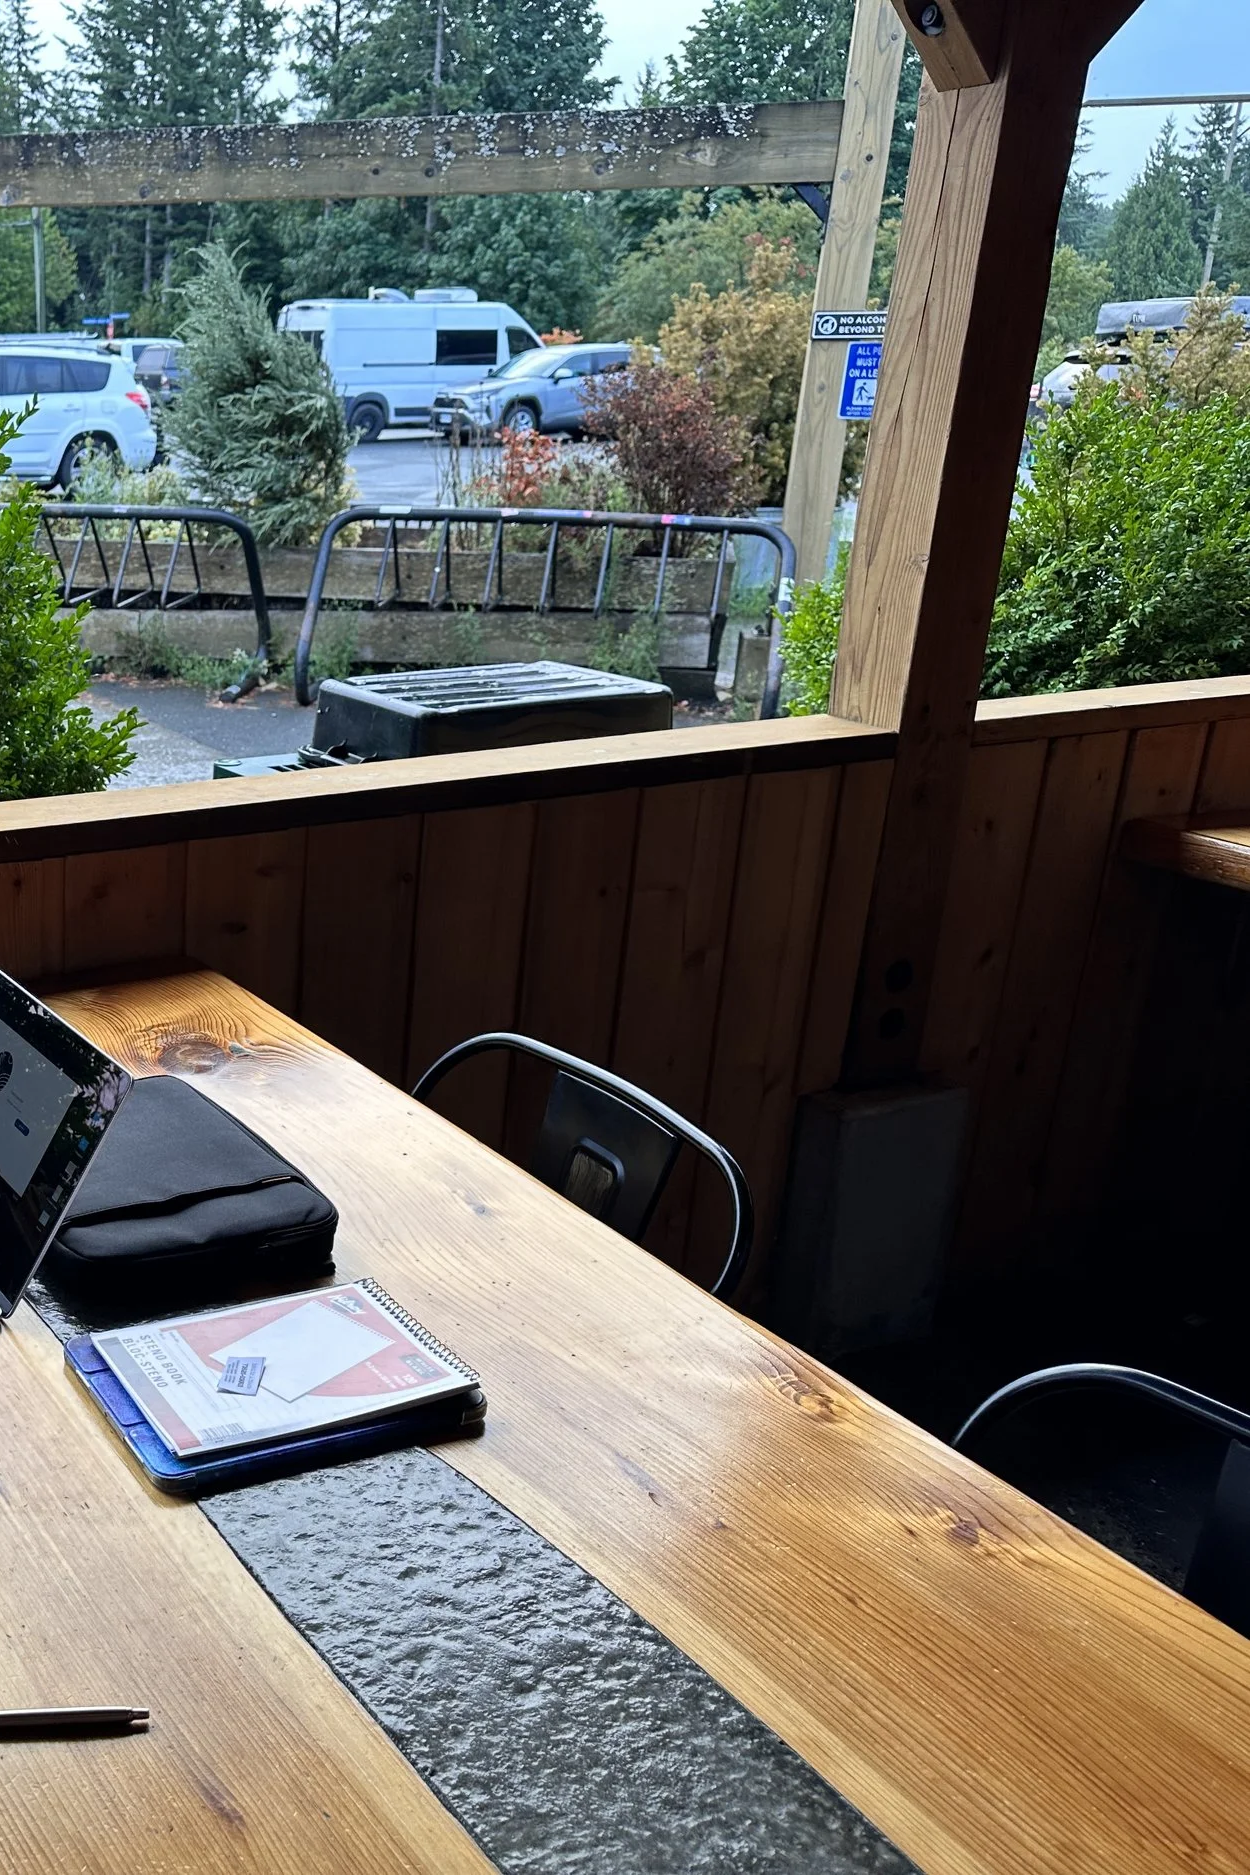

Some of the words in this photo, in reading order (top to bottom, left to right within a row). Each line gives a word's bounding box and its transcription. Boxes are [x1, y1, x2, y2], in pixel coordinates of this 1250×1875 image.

[839, 316, 854, 324] NO
[855, 316, 887, 324] ALCOH
[839, 325, 875, 334] BEYOND
[856, 346, 871, 356] ALL
[856, 357, 878, 367] MUST
[121, 1338, 168, 1388] BLOC-STENO
[139, 1334, 167, 1361] STENO
[161, 1362, 188, 1385] BOOK
